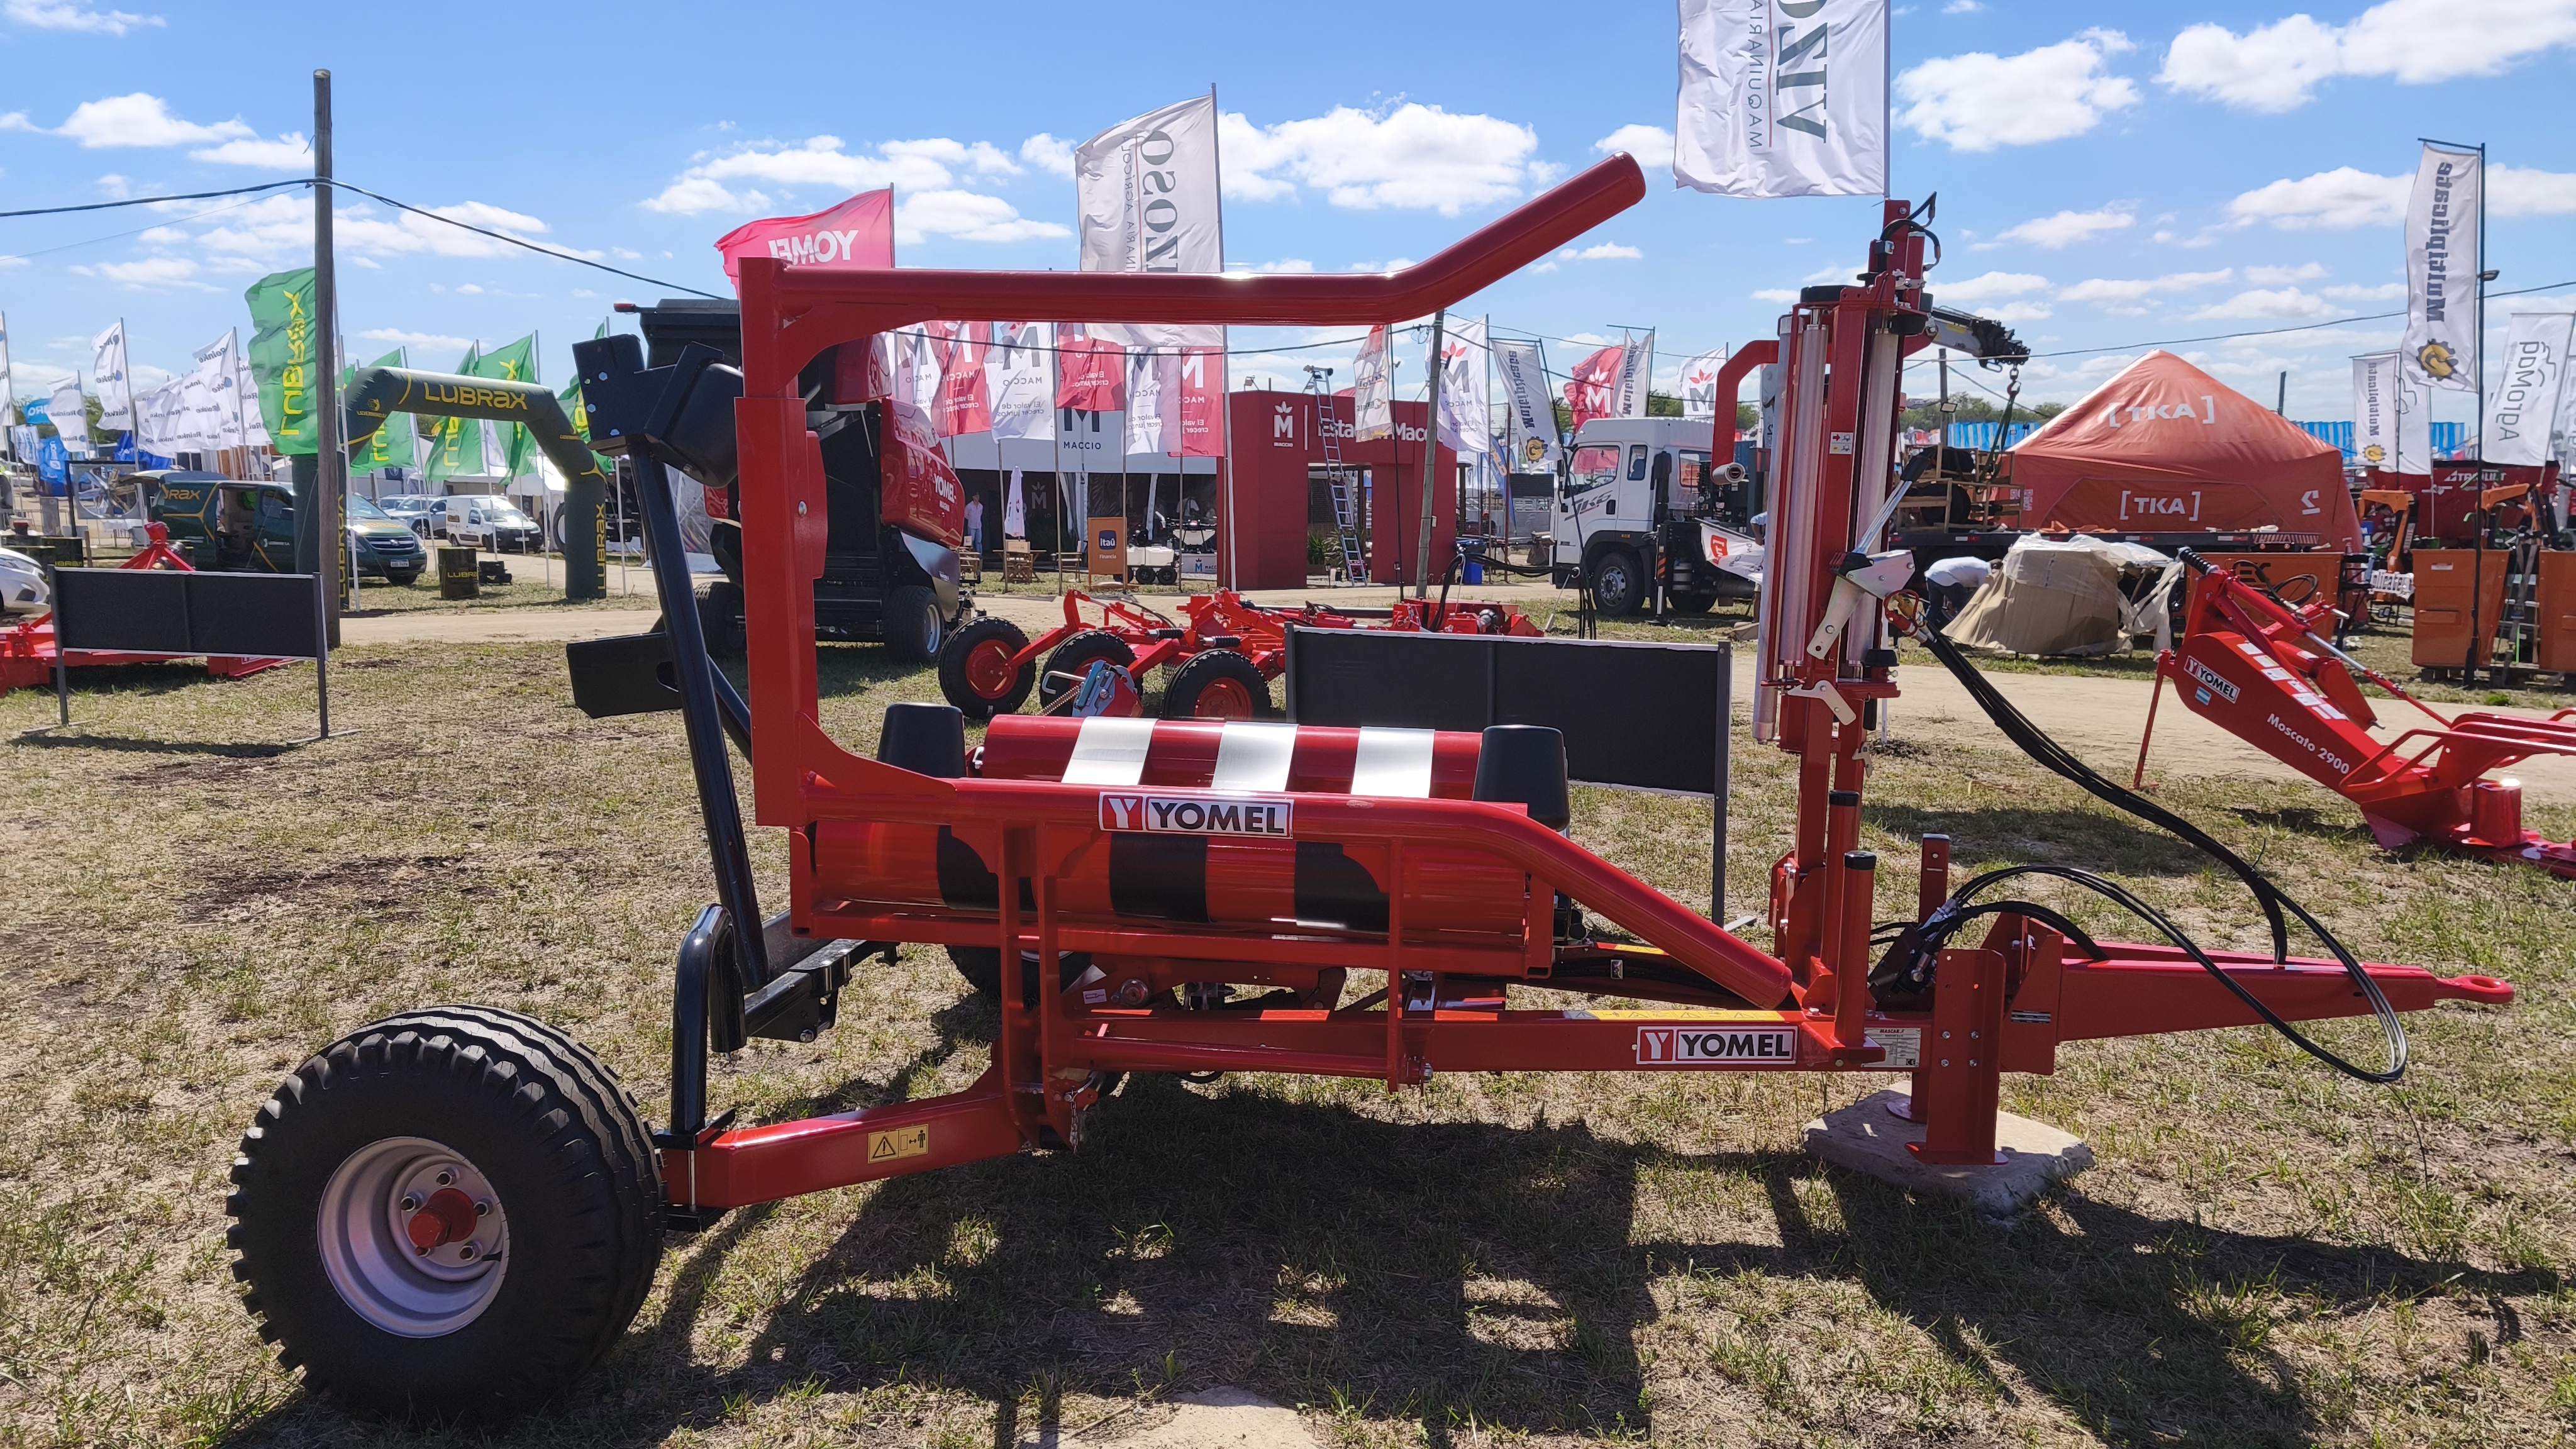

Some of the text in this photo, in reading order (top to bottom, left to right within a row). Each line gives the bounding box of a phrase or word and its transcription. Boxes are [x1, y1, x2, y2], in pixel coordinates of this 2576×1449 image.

[423, 381, 528, 411] LUBRAX
[1274, 414, 1293, 438] M
[1063, 441, 1101, 450] MACCIO
[934, 472, 956, 503] YOMEL
[596, 503, 605, 590] LUBRAX
[2186, 659, 2235, 699] Y YOMEL
[2267, 713, 2350, 775] Moscato 2900
[1108, 798, 1285, 834] Y YOMEL
[1642, 1032, 1790, 1060] Y YOMEL
